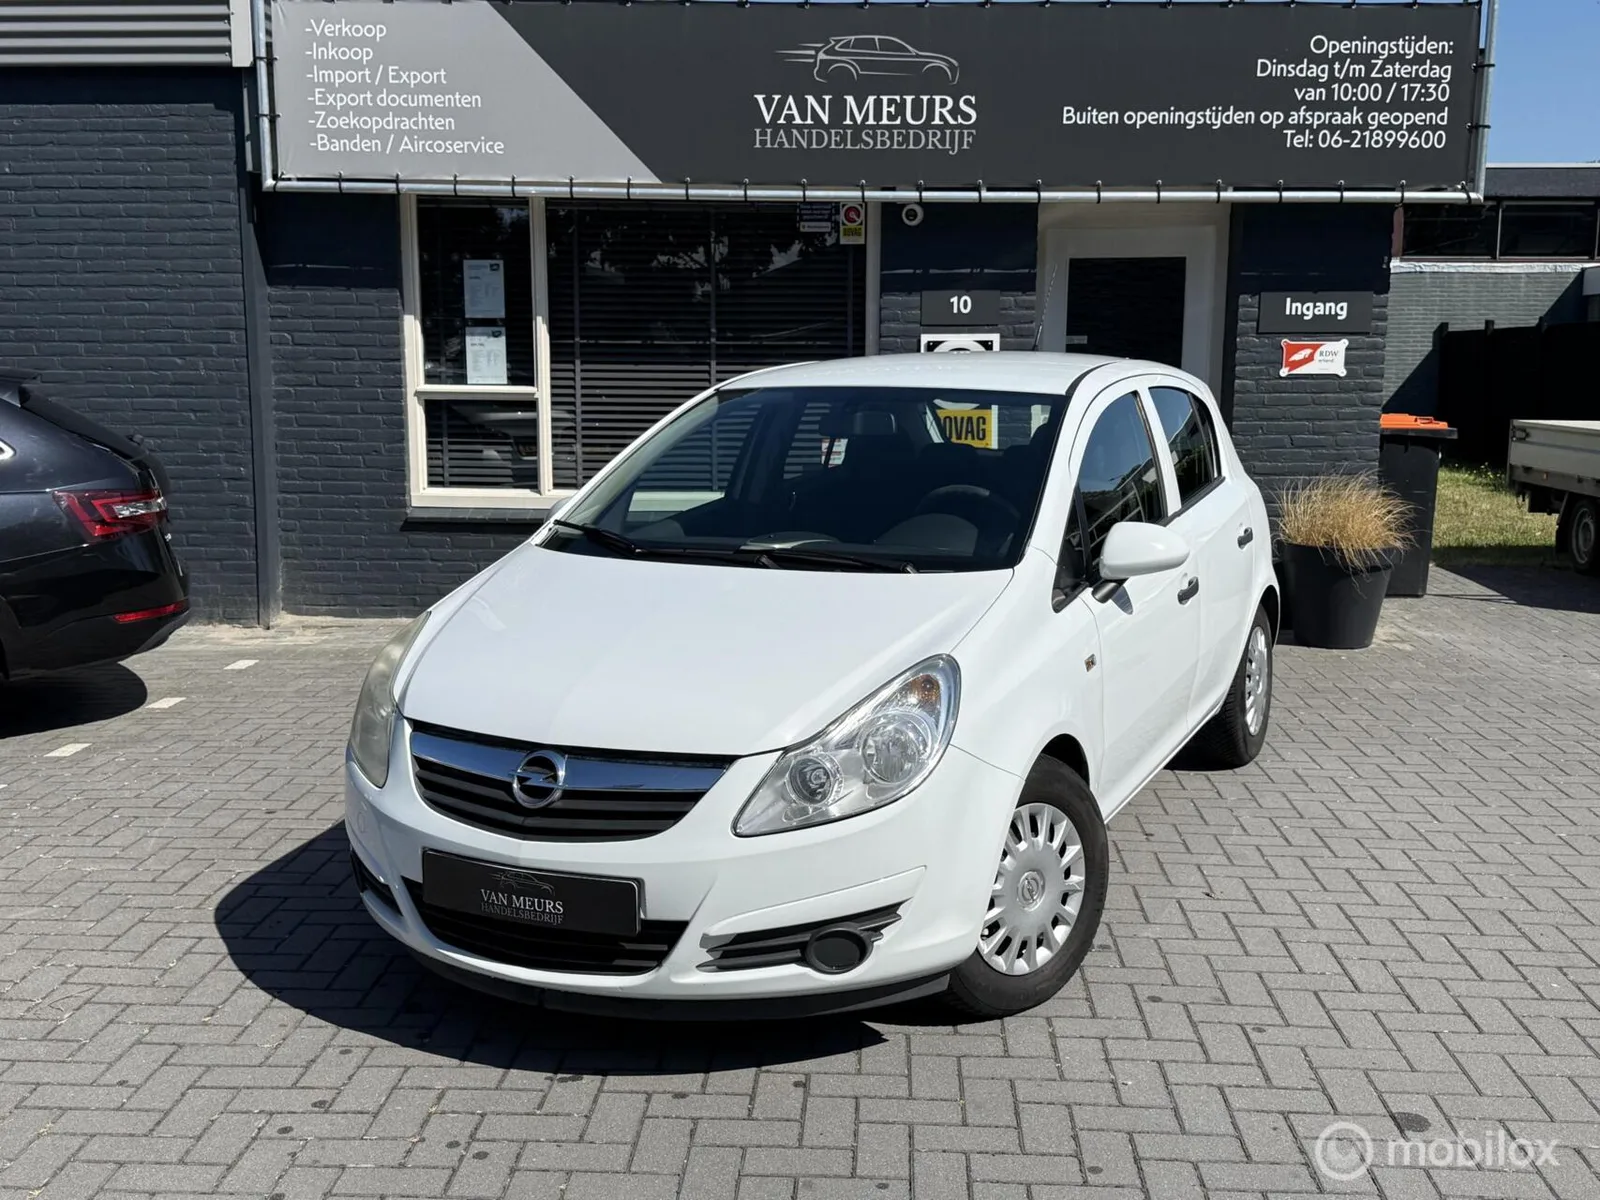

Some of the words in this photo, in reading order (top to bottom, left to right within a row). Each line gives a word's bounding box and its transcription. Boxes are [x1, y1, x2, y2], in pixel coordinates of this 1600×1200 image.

[305, 19, 386, 41] -Verkoop
[305, 42, 373, 64] -Inkoop
[1310, 35, 1453, 59] Openingstijden:
[307, 65, 371, 87] -Import
[375, 65, 384, 86] /
[389, 66, 446, 88] Export
[1257, 59, 1328, 82] Dinsdag
[1334, 58, 1365, 79] t/m
[1371, 58, 1451, 82] Zaterdag
[308, 89, 373, 110] -Export
[377, 89, 481, 107] documenten
[1294, 87, 1326, 101] van
[1332, 83, 1382, 101] 10:00
[1386, 82, 1396, 103] /
[1401, 82, 1449, 101] 17:30
[754, 95, 831, 124] VAN
[843, 95, 976, 124] MEURS
[1063, 107, 1118, 124] Buiten
[1124, 106, 1254, 129] openingstijden
[1260, 111, 1284, 129] op
[1289, 106, 1363, 130] afspraak
[1368, 107, 1448, 129] geopend
[308, 111, 454, 133] -Zoekopdrachten
[310, 135, 381, 152] -Banden
[386, 134, 395, 155] /
[399, 136, 504, 154] Aircoservice
[753, 129, 976, 154] HANDELSBEDRIJF
[1283, 129, 1313, 147] Tel:
[1319, 130, 1445, 148] 06-21899600
[950, 296, 971, 313] 10
[1286, 298, 1347, 320] Ingang
[943, 416, 986, 440] OVAG
[481, 889, 507, 905] VAN
[512, 895, 563, 914] MEURS
[481, 903, 564, 925] HANDELSBEDRIJF
